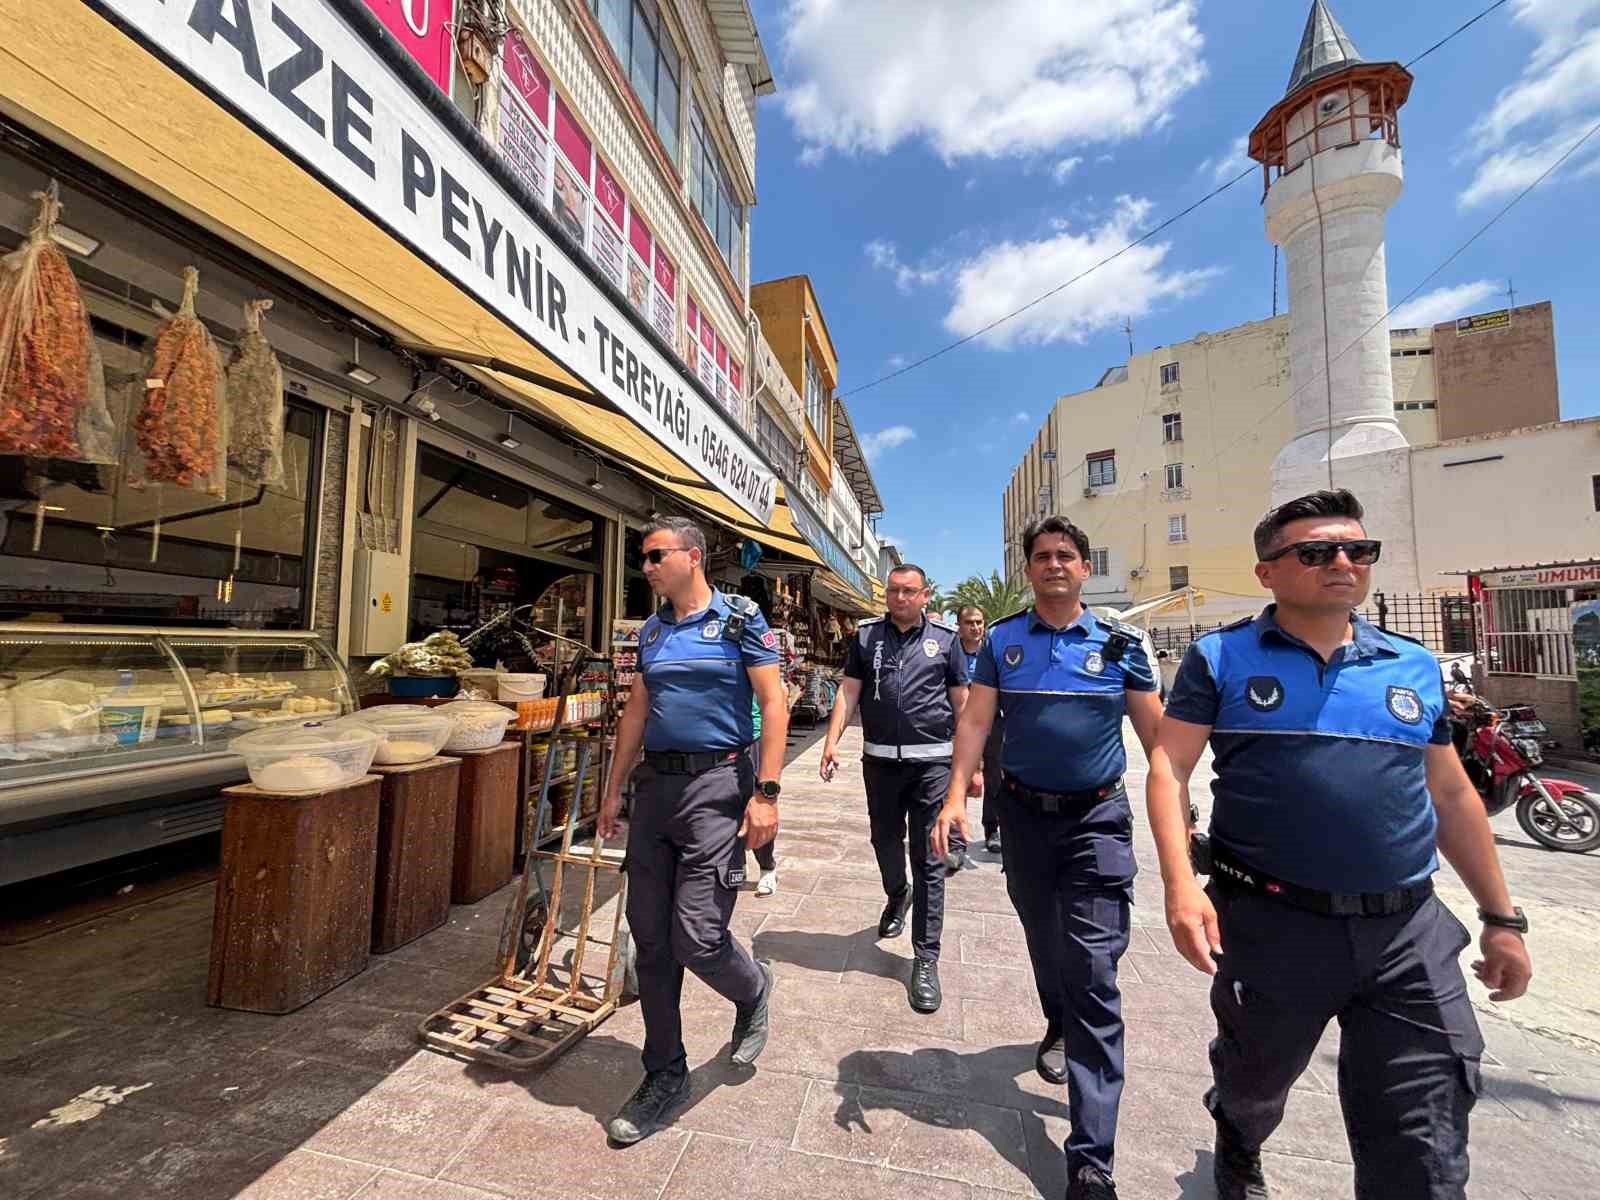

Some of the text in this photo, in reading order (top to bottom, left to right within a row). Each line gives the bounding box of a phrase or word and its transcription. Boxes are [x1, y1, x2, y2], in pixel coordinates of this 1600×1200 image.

[158, 0, 376, 181] AZE
[401, 128, 569, 344] PEYNİR
[593, 316, 690, 446] TEREYAĞI
[702, 424, 729, 479] 0546
[730, 453, 748, 495] 624
[748, 470, 760, 503] 07
[759, 481, 769, 512] 44
[873, 641, 884, 700] ZABITA
